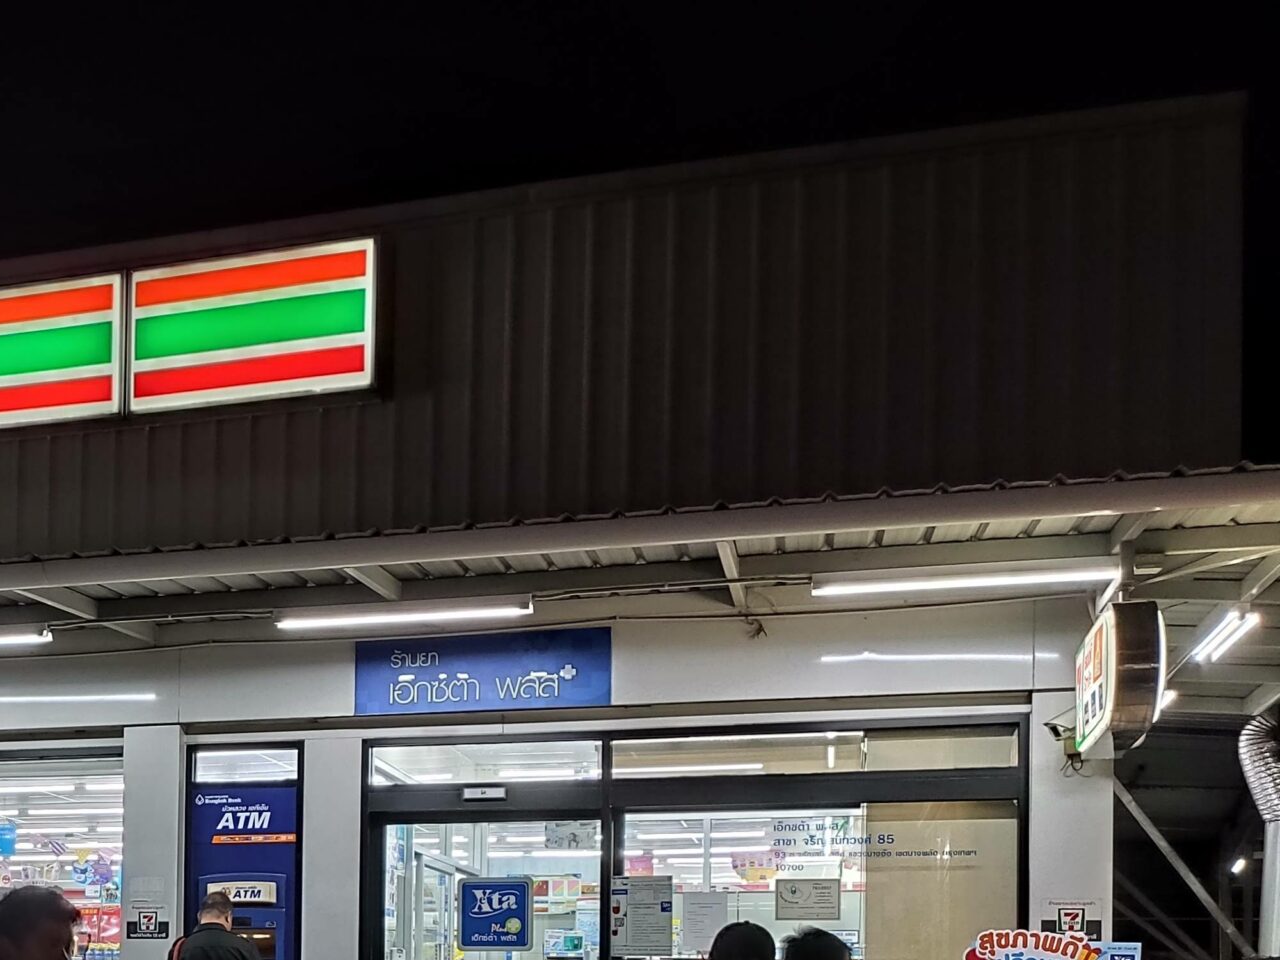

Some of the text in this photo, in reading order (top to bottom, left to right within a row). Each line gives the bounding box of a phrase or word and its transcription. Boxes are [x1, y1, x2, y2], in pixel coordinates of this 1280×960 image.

[390, 651, 439, 669] ร้านยา
[495, 671, 559, 699] พลัส
[216, 812, 271, 830] ATM
[773, 838, 797, 846] สาขา
[877, 834, 895, 845] 85
[774, 851, 786, 859] 93
[233, 889, 262, 899] ATM
[1063, 912, 1080, 931] 7
[978, 931, 1085, 960] สุขภาพดี
